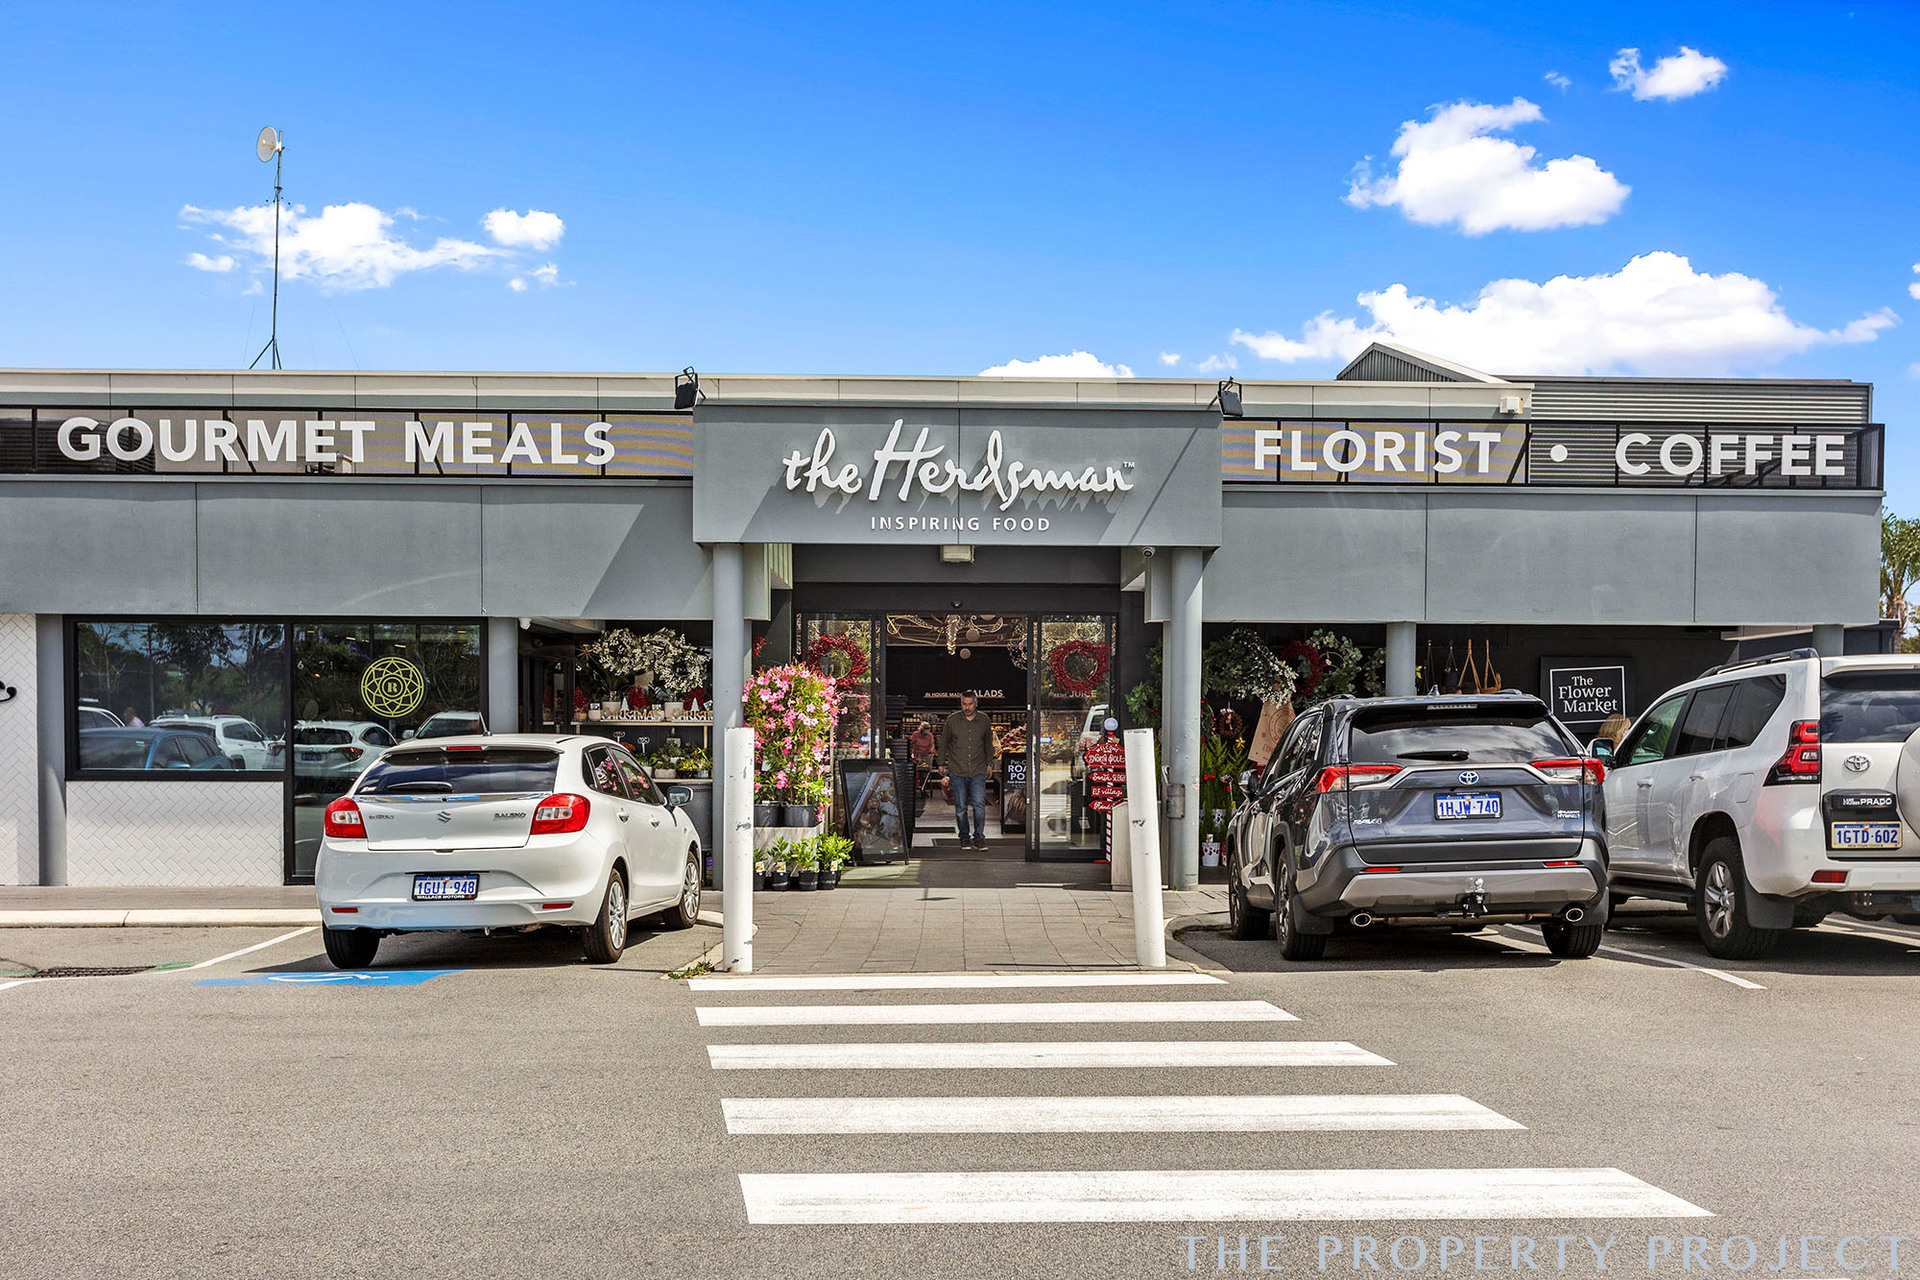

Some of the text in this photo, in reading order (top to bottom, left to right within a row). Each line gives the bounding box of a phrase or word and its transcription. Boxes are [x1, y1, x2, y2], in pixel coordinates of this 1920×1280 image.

[57, 417, 615, 465] GOURMET MEALS
[1254, 429, 1501, 473] FLORIST
[1615, 433, 1845, 475] COFFEE
[782, 427, 862, 492] the
[868, 418, 1135, 511] Herdsman
[871, 516, 1050, 532] INSPIRING FOOD
[387, 682, 398, 693] R
[1571, 676, 1594, 686] The
[1558, 685, 1612, 699] Flower
[1563, 698, 1618, 714] Market
[1860, 798, 1892, 806] PRADO
